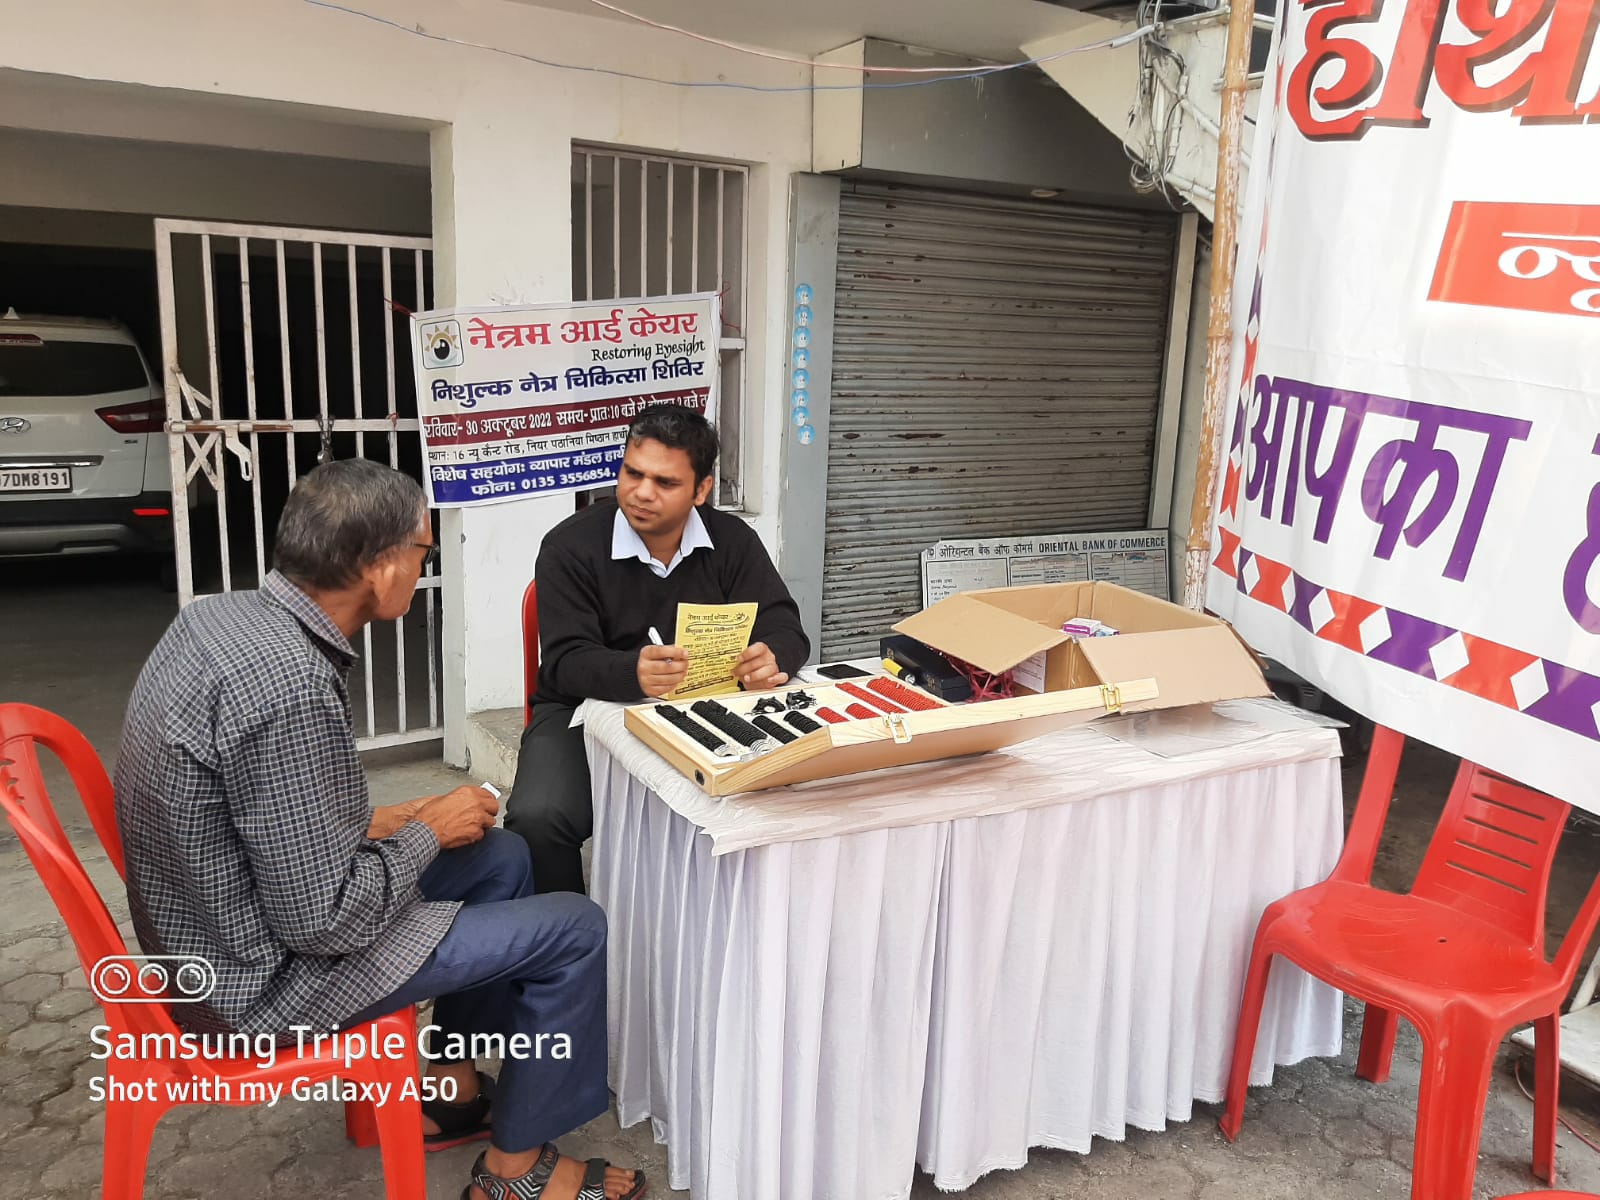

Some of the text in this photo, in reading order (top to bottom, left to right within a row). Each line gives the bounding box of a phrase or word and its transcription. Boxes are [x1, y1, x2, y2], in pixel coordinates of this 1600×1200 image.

[1287, 0, 1600, 142] हाथ
[467, 307, 698, 349] नेत्रम आई केयर
[591, 334, 706, 361] Restoring Eyesight
[431, 356, 705, 408] निशुल्क नेत्र चिकित्सा शिविर
[466, 419, 478, 435] 30
[529, 411, 552, 428] 2022
[467, 448, 480, 462] न्यू
[526, 439, 548, 452] नियर
[0, 472, 68, 487] 7DM8191
[431, 466, 467, 481] विशेष
[529, 457, 570, 471] व्यापार
[573, 451, 602, 466] मंडल
[1245, 373, 1533, 583] आपका
[471, 480, 516, 496] फोन:
[522, 476, 555, 490] 0135
[1038, 537, 1166, 553] ORIENTAL BANK OF COMMERCE
